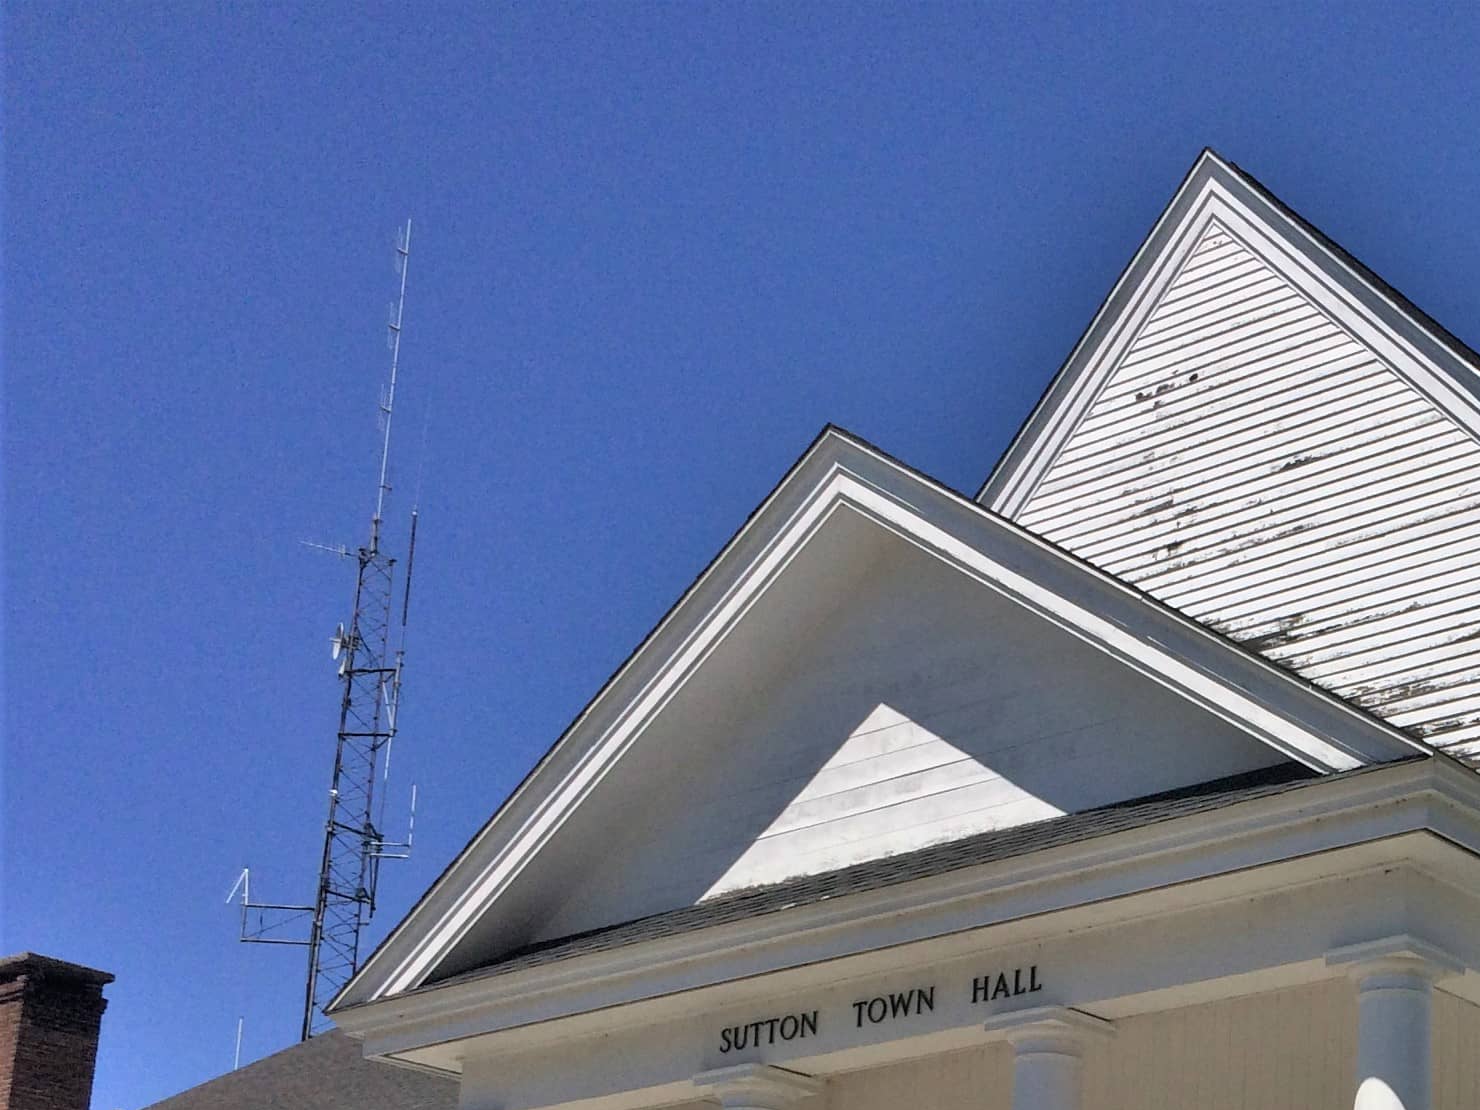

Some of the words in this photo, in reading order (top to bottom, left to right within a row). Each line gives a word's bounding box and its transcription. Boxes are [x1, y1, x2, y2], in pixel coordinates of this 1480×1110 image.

[718, 1010, 818, 1053] SUTTON
[853, 986, 935, 1027] TOWN
[971, 966, 1042, 1003] HALL
